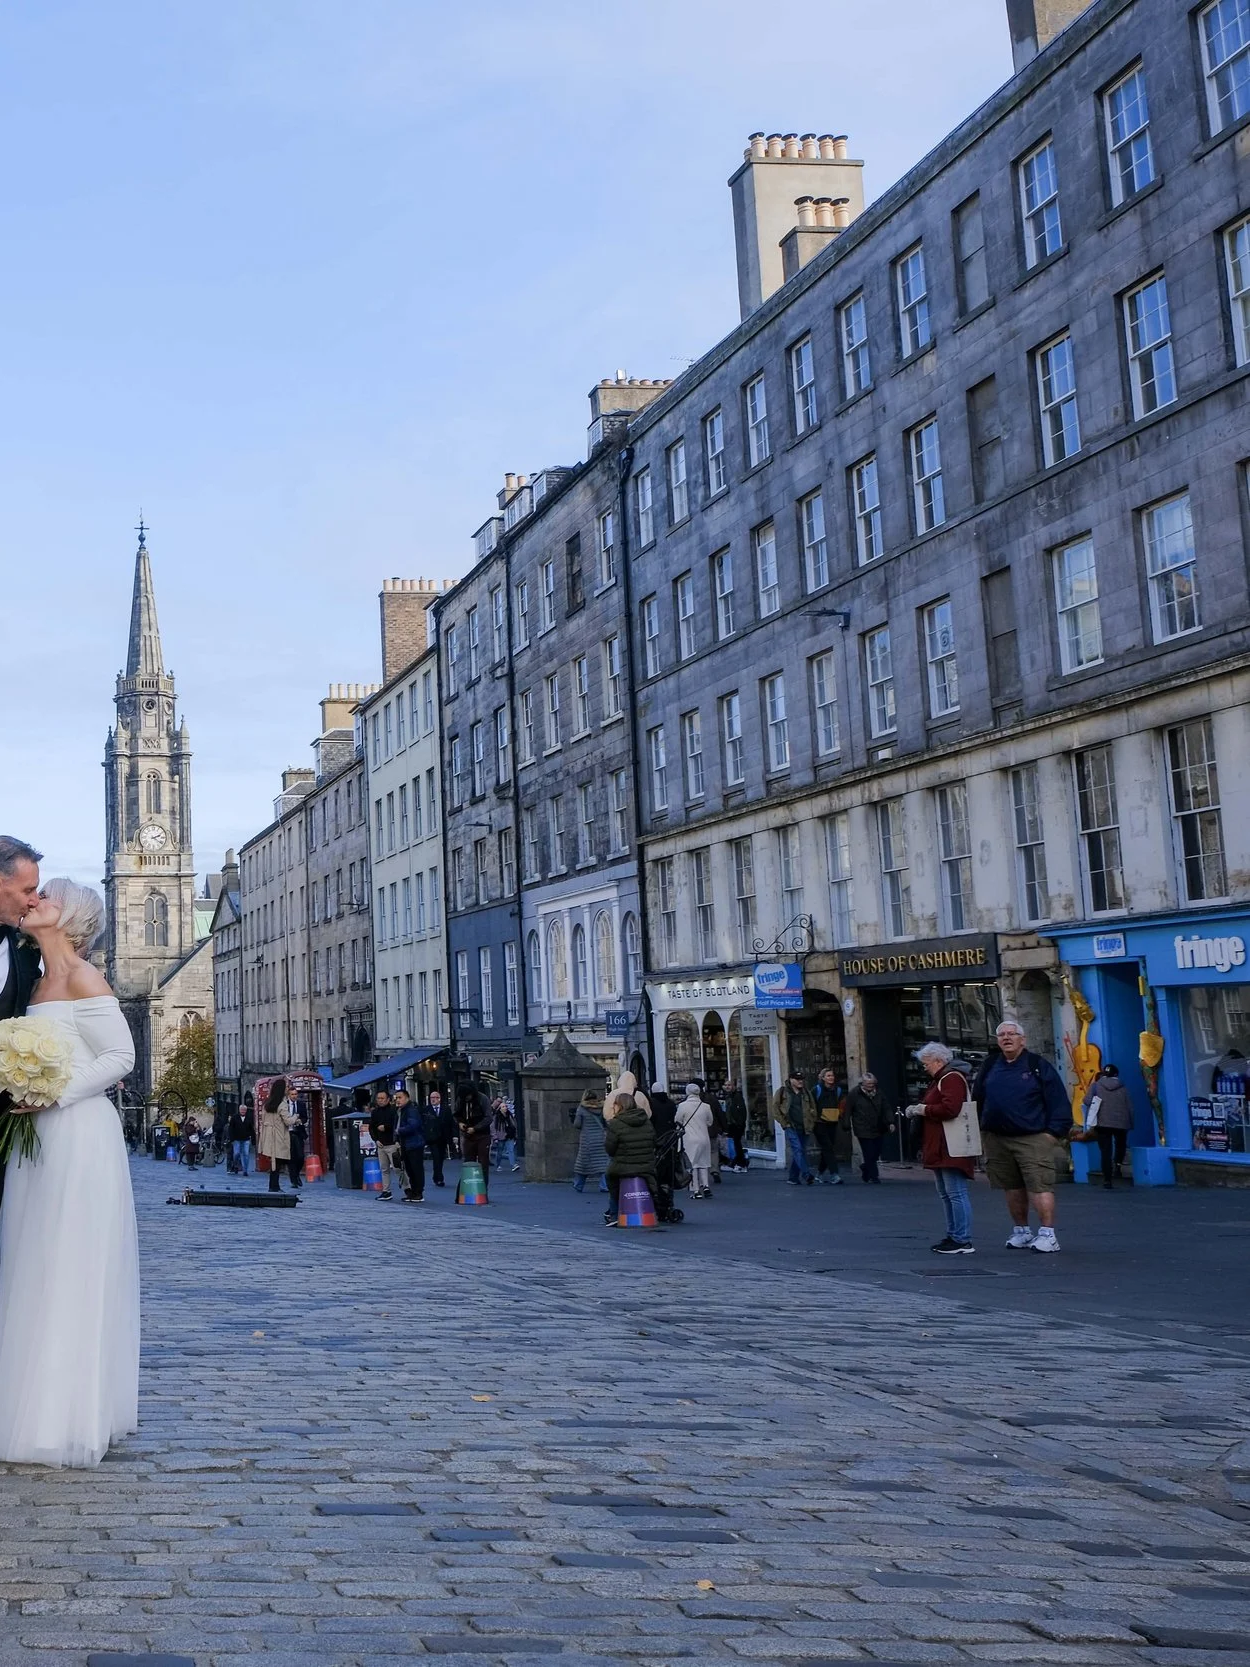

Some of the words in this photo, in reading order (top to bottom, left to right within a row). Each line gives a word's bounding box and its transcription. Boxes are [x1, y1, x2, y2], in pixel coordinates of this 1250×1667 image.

[843, 957, 885, 976] HOUSE
[888, 955, 907, 972] OF
[908, 947, 986, 970] CASHMERE
[1174, 935, 1246, 973] fringe
[757, 969, 786, 985] fringe
[667, 989, 691, 999] TASTE
[693, 988, 702, 998] OF
[705, 985, 750, 997] SCOTLAND
[609, 1015, 626, 1025] 166
